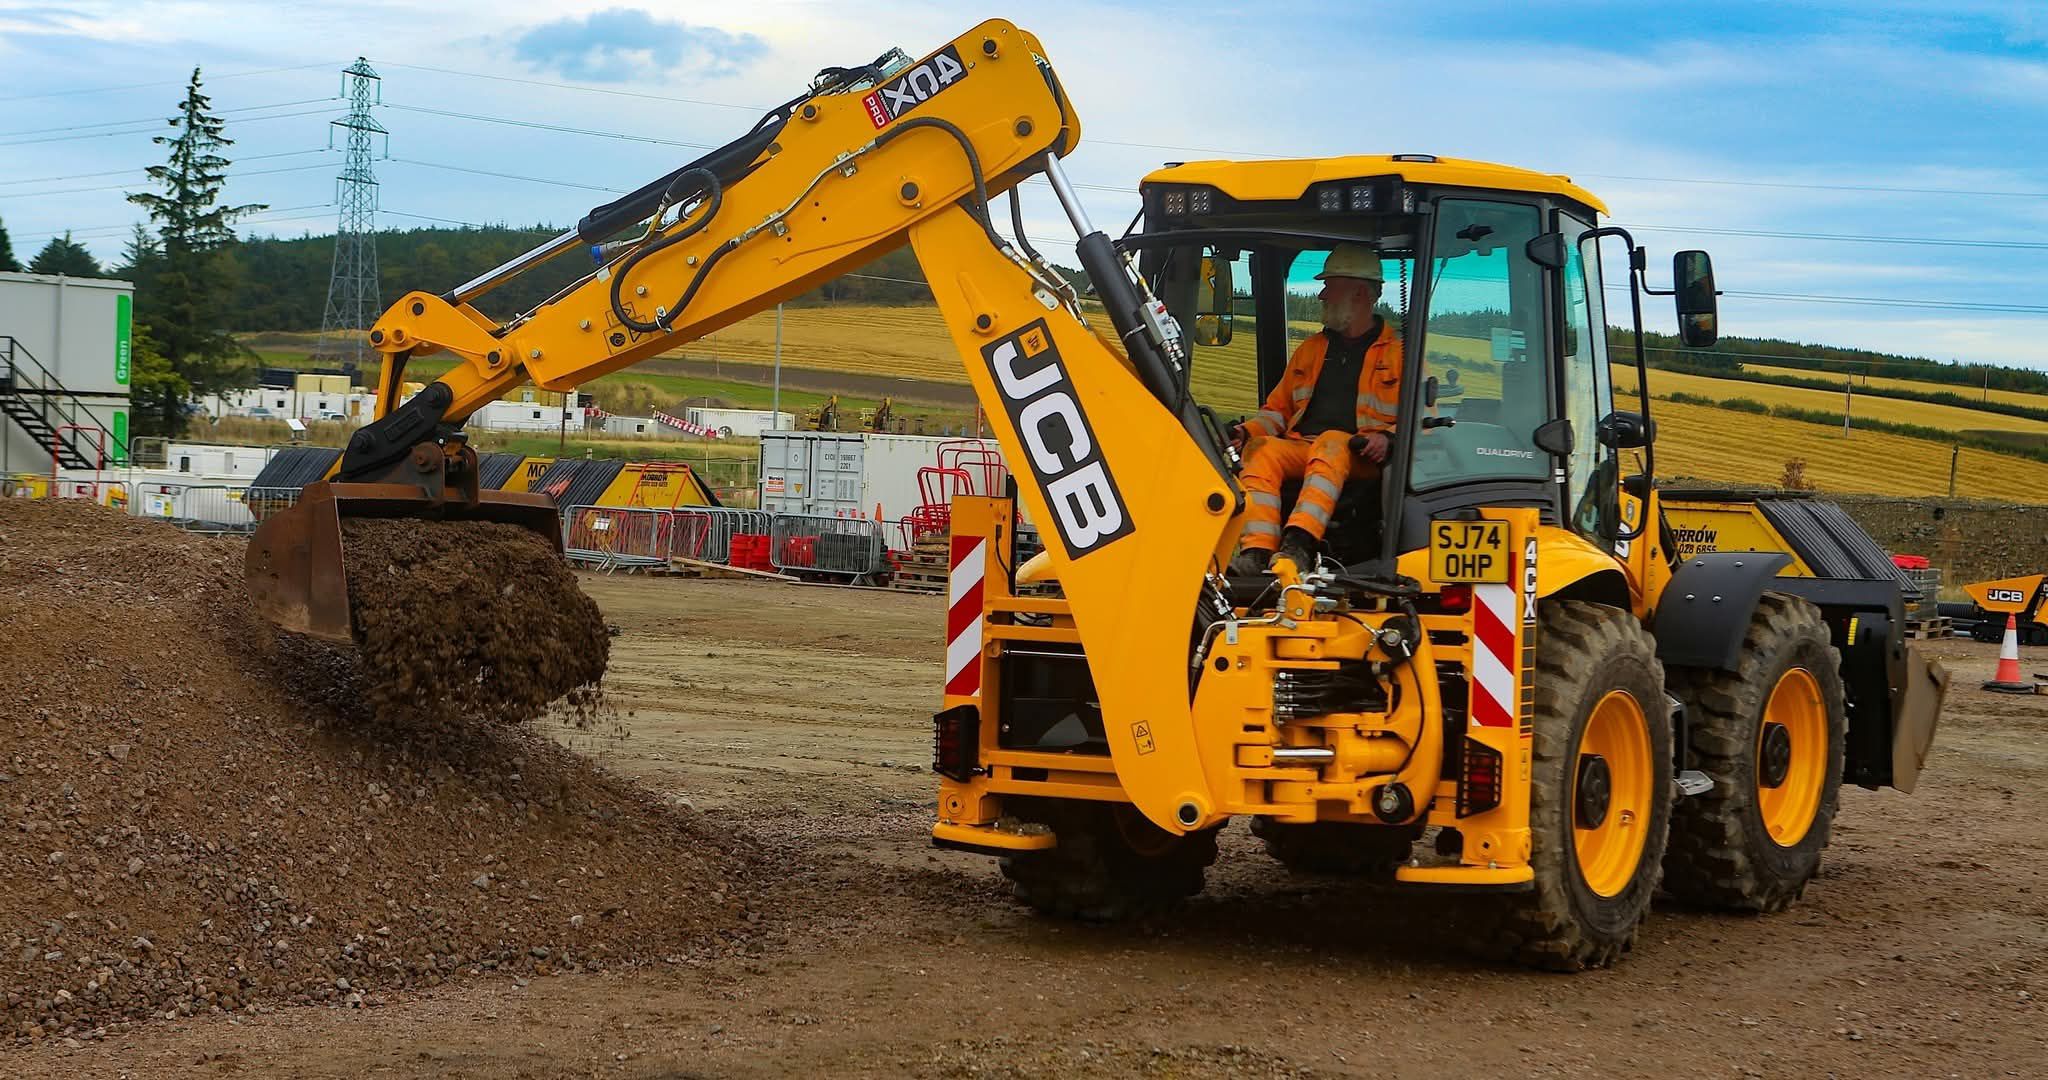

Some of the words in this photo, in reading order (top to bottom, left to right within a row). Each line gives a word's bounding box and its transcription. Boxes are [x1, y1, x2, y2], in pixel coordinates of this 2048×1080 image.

[883, 53, 963, 117] 4CX
[865, 96, 886, 126] PRO
[117, 340, 129, 379] Green
[992, 340, 1123, 549] JCB
[1476, 447, 1535, 459] DUALDRIVE
[1438, 526, 1501, 550] SJ74
[1446, 554, 1493, 578] OHP
[1524, 540, 1537, 619] 4CX
[1988, 590, 2023, 602] JCB
